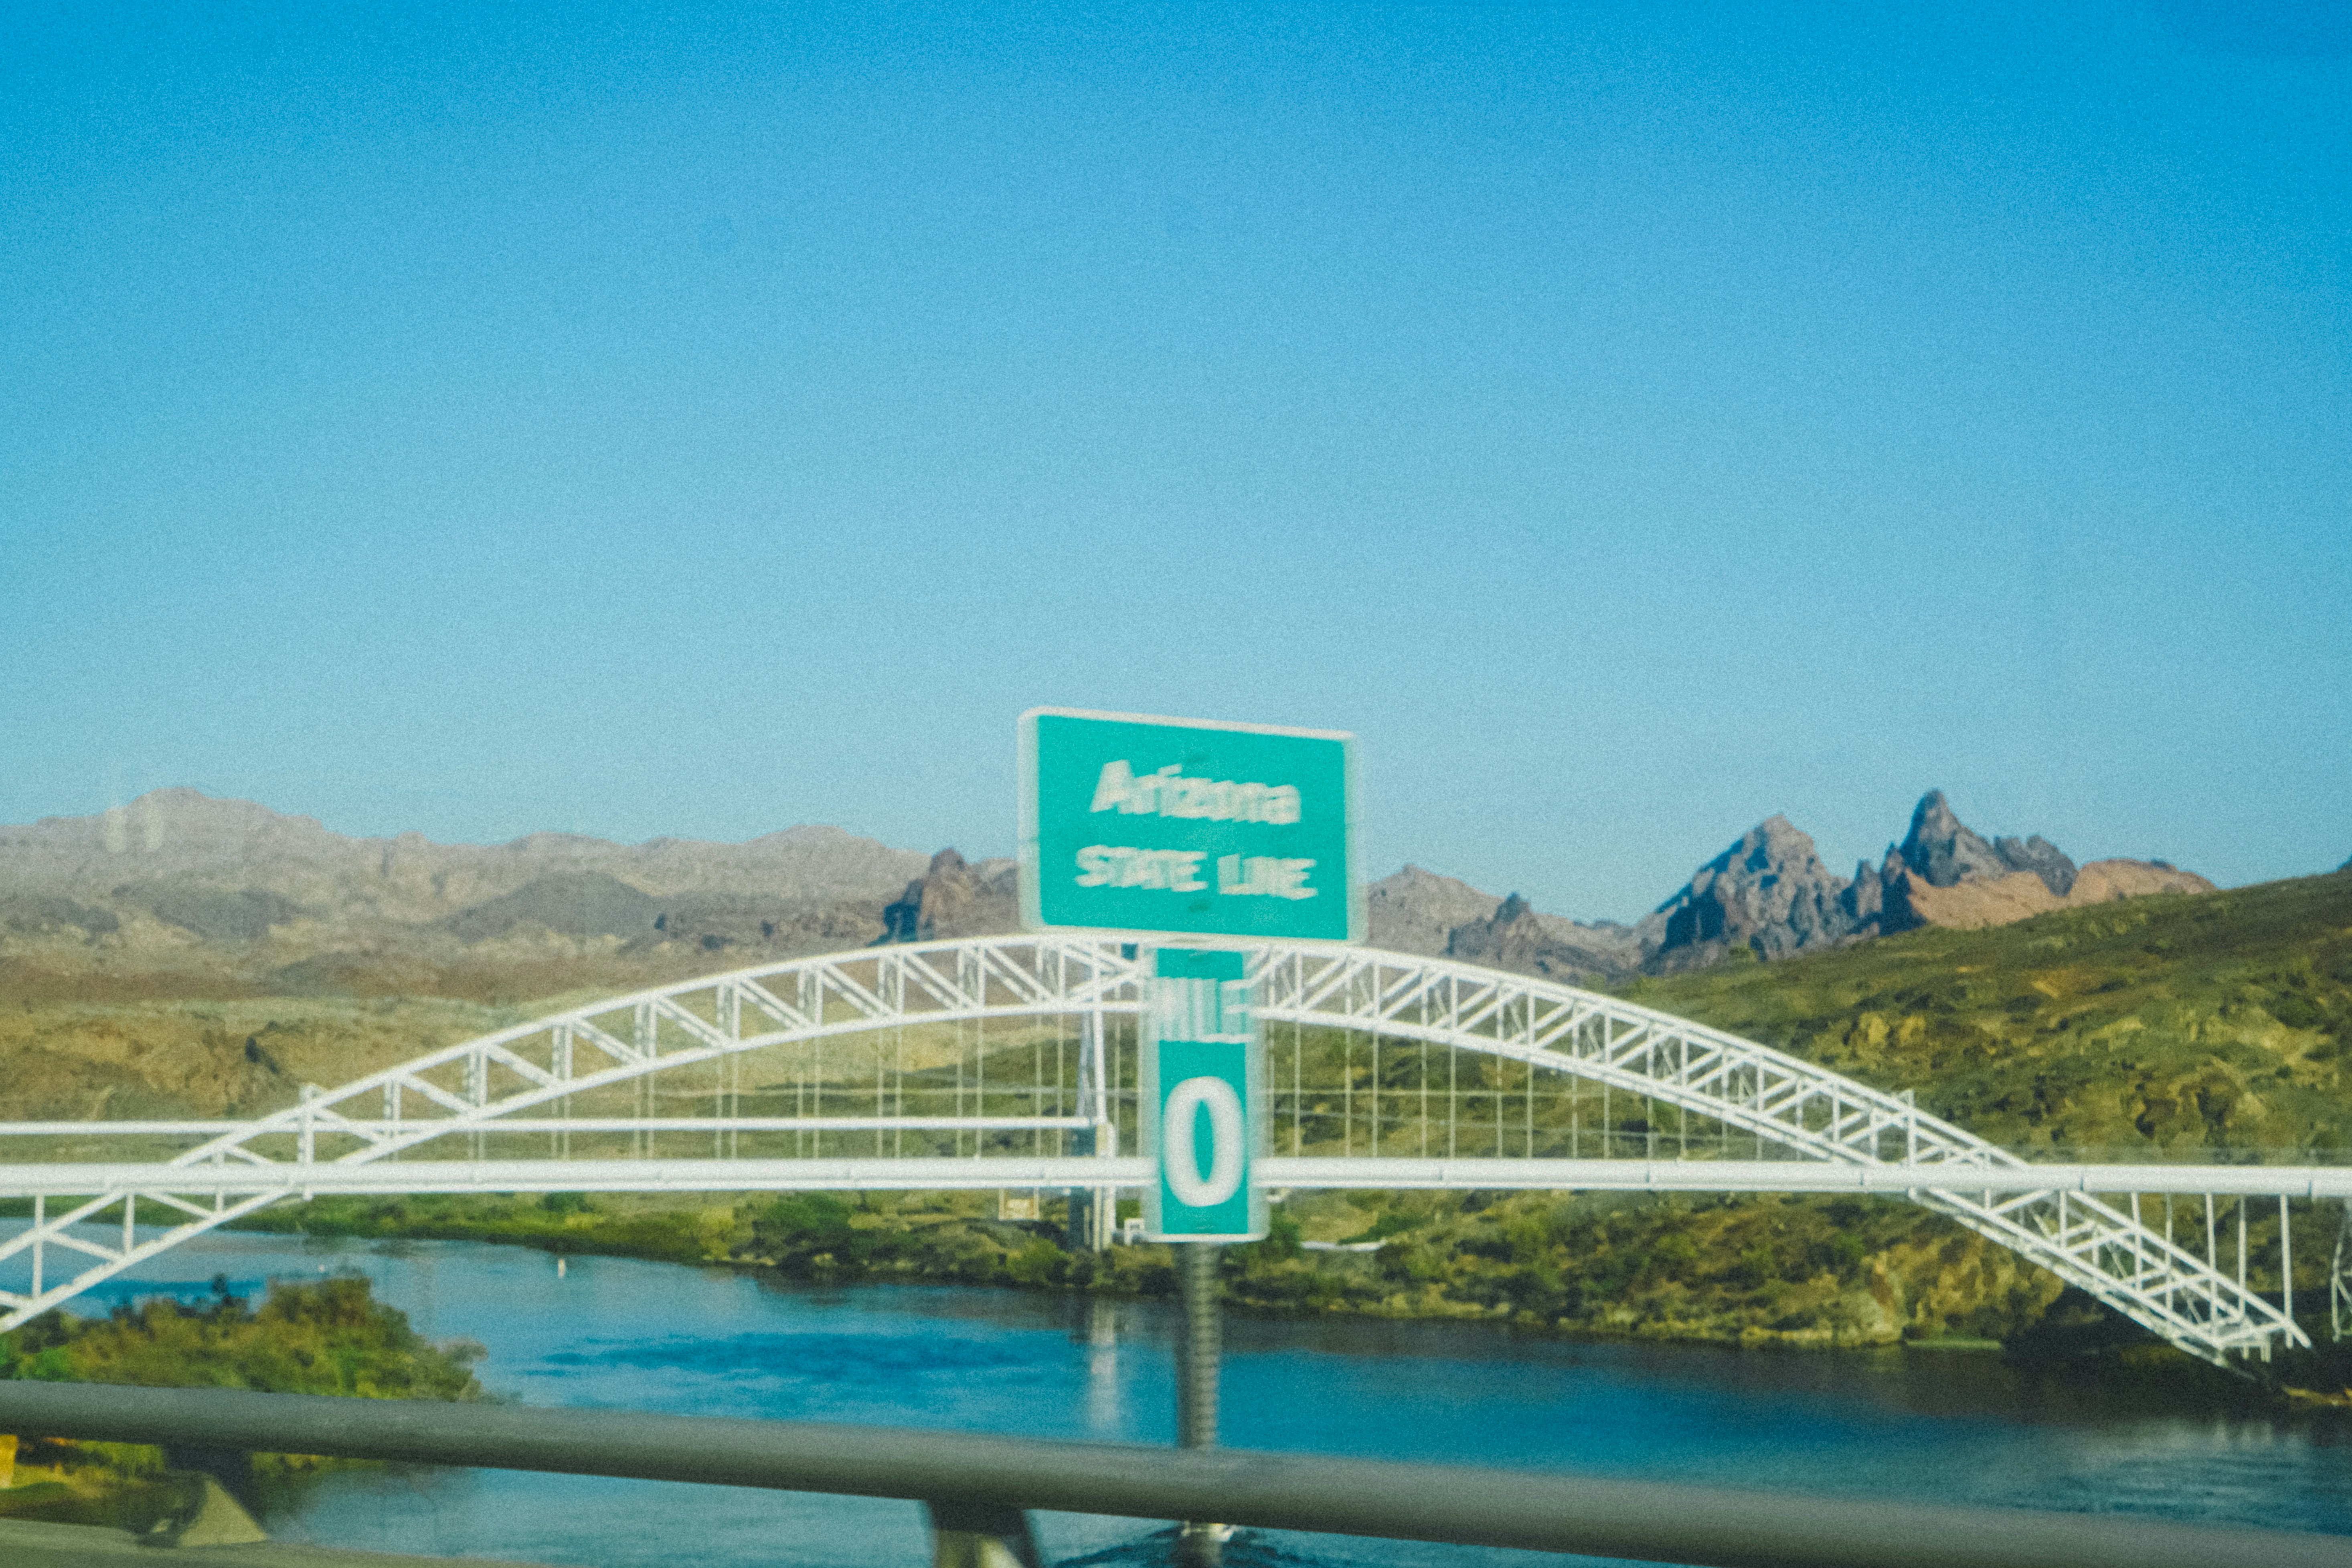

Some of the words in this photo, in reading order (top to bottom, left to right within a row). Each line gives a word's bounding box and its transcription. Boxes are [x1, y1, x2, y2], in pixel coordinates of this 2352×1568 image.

[1090, 760, 1301, 825] Arizona
[1075, 845, 1208, 892] STATE
[1217, 853, 1318, 900] LINE
[1150, 977, 1256, 1044] MILE
[1163, 1076, 1246, 1207] 0
